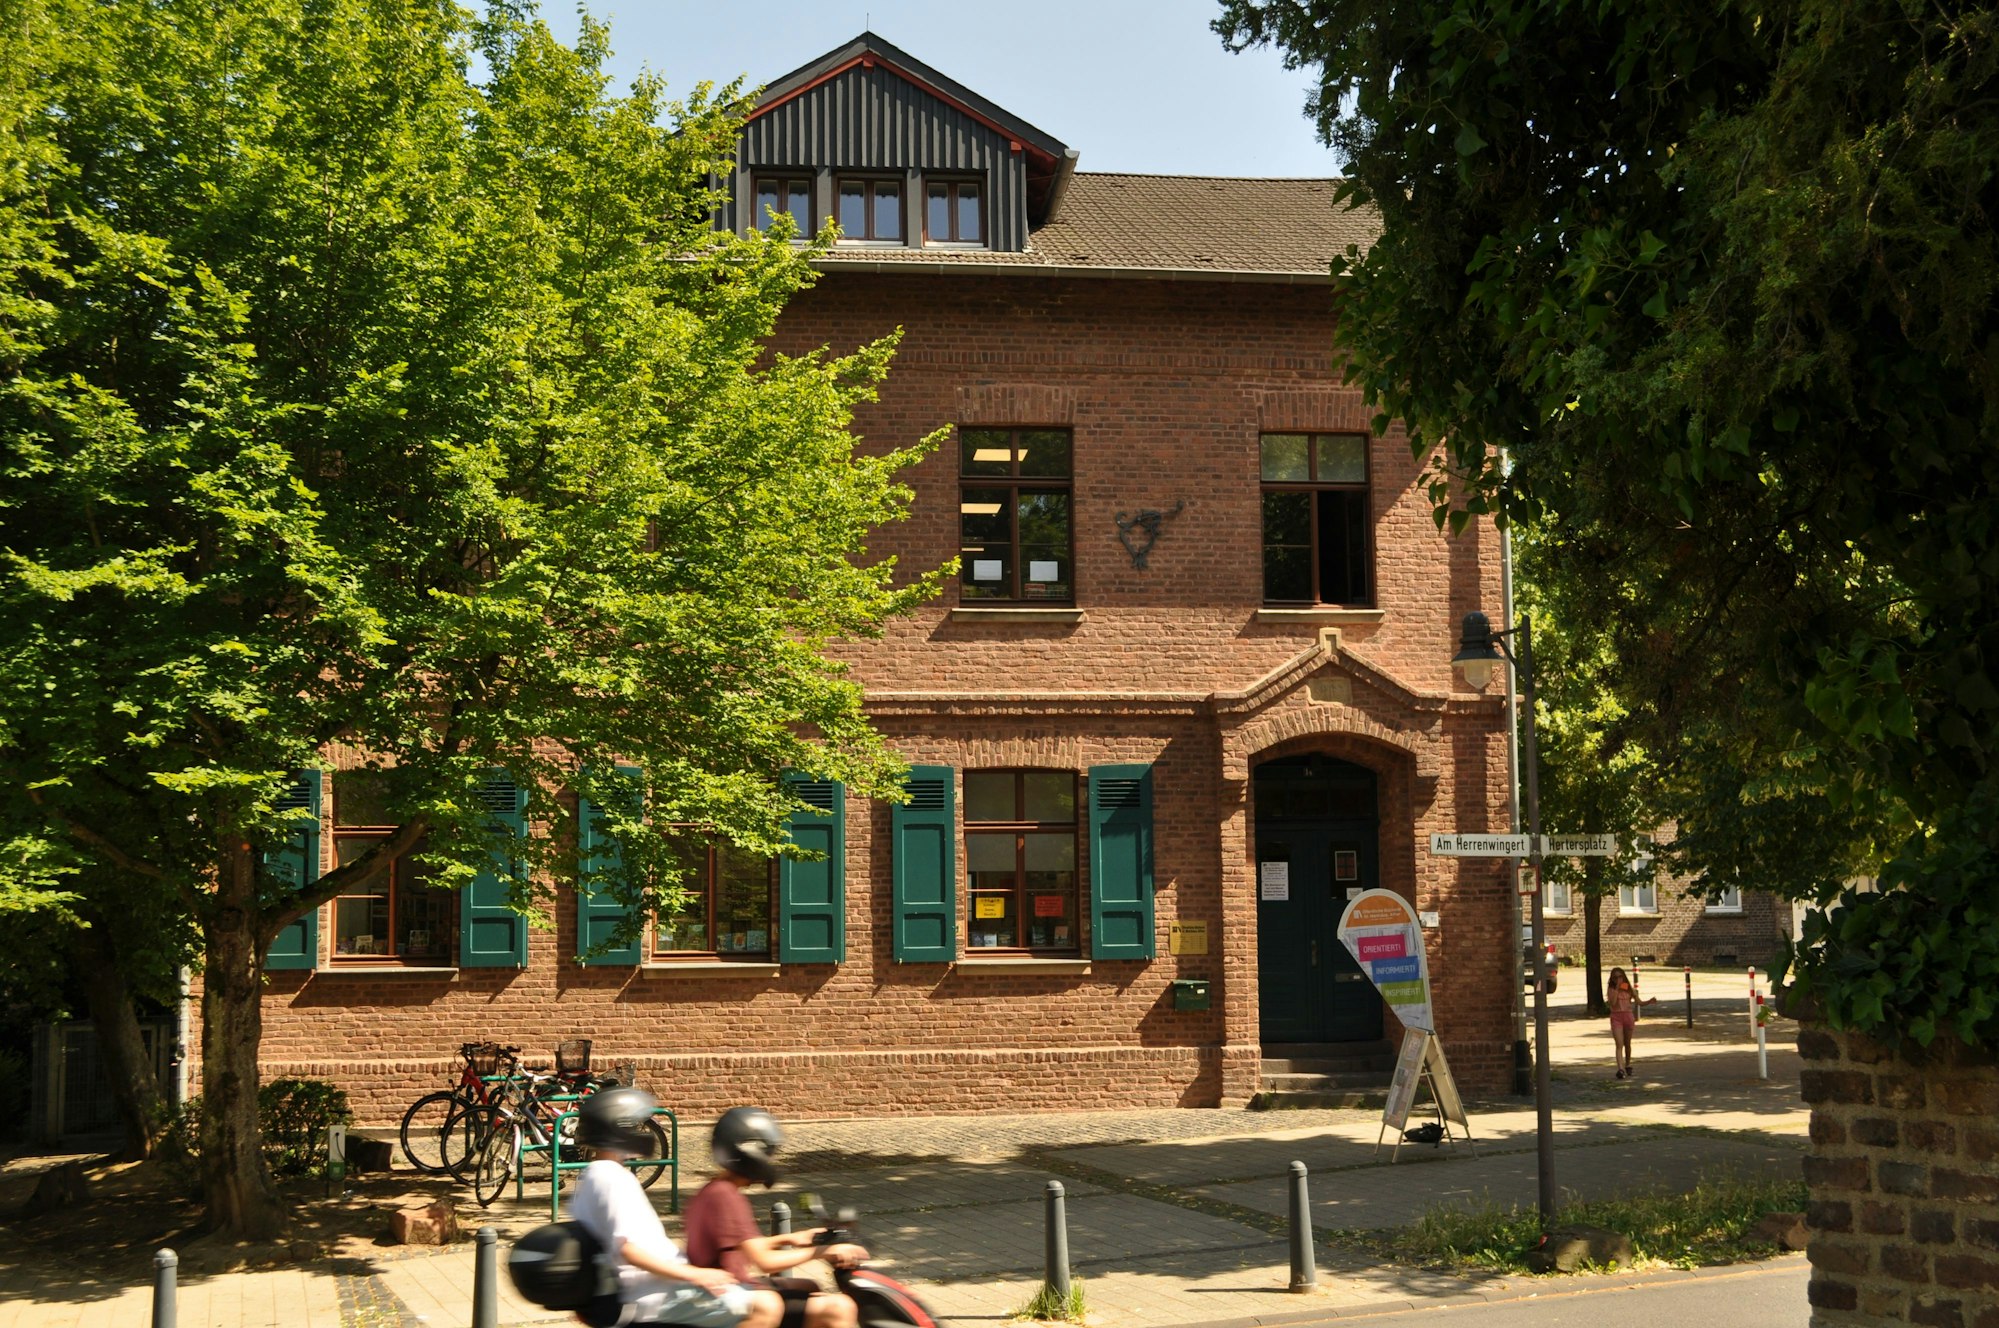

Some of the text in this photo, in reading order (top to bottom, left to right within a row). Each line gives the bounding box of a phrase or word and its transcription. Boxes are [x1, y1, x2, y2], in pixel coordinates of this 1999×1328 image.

[1436, 837, 1525, 854] Am Herrenwingert
[1549, 837, 1607, 853] Hertersplatz
[1363, 943, 1401, 954] ORIENTIERT!
[1375, 964, 1416, 975] INFORMIERT!
[1385, 987, 1421, 997] INSPIRIERT!
